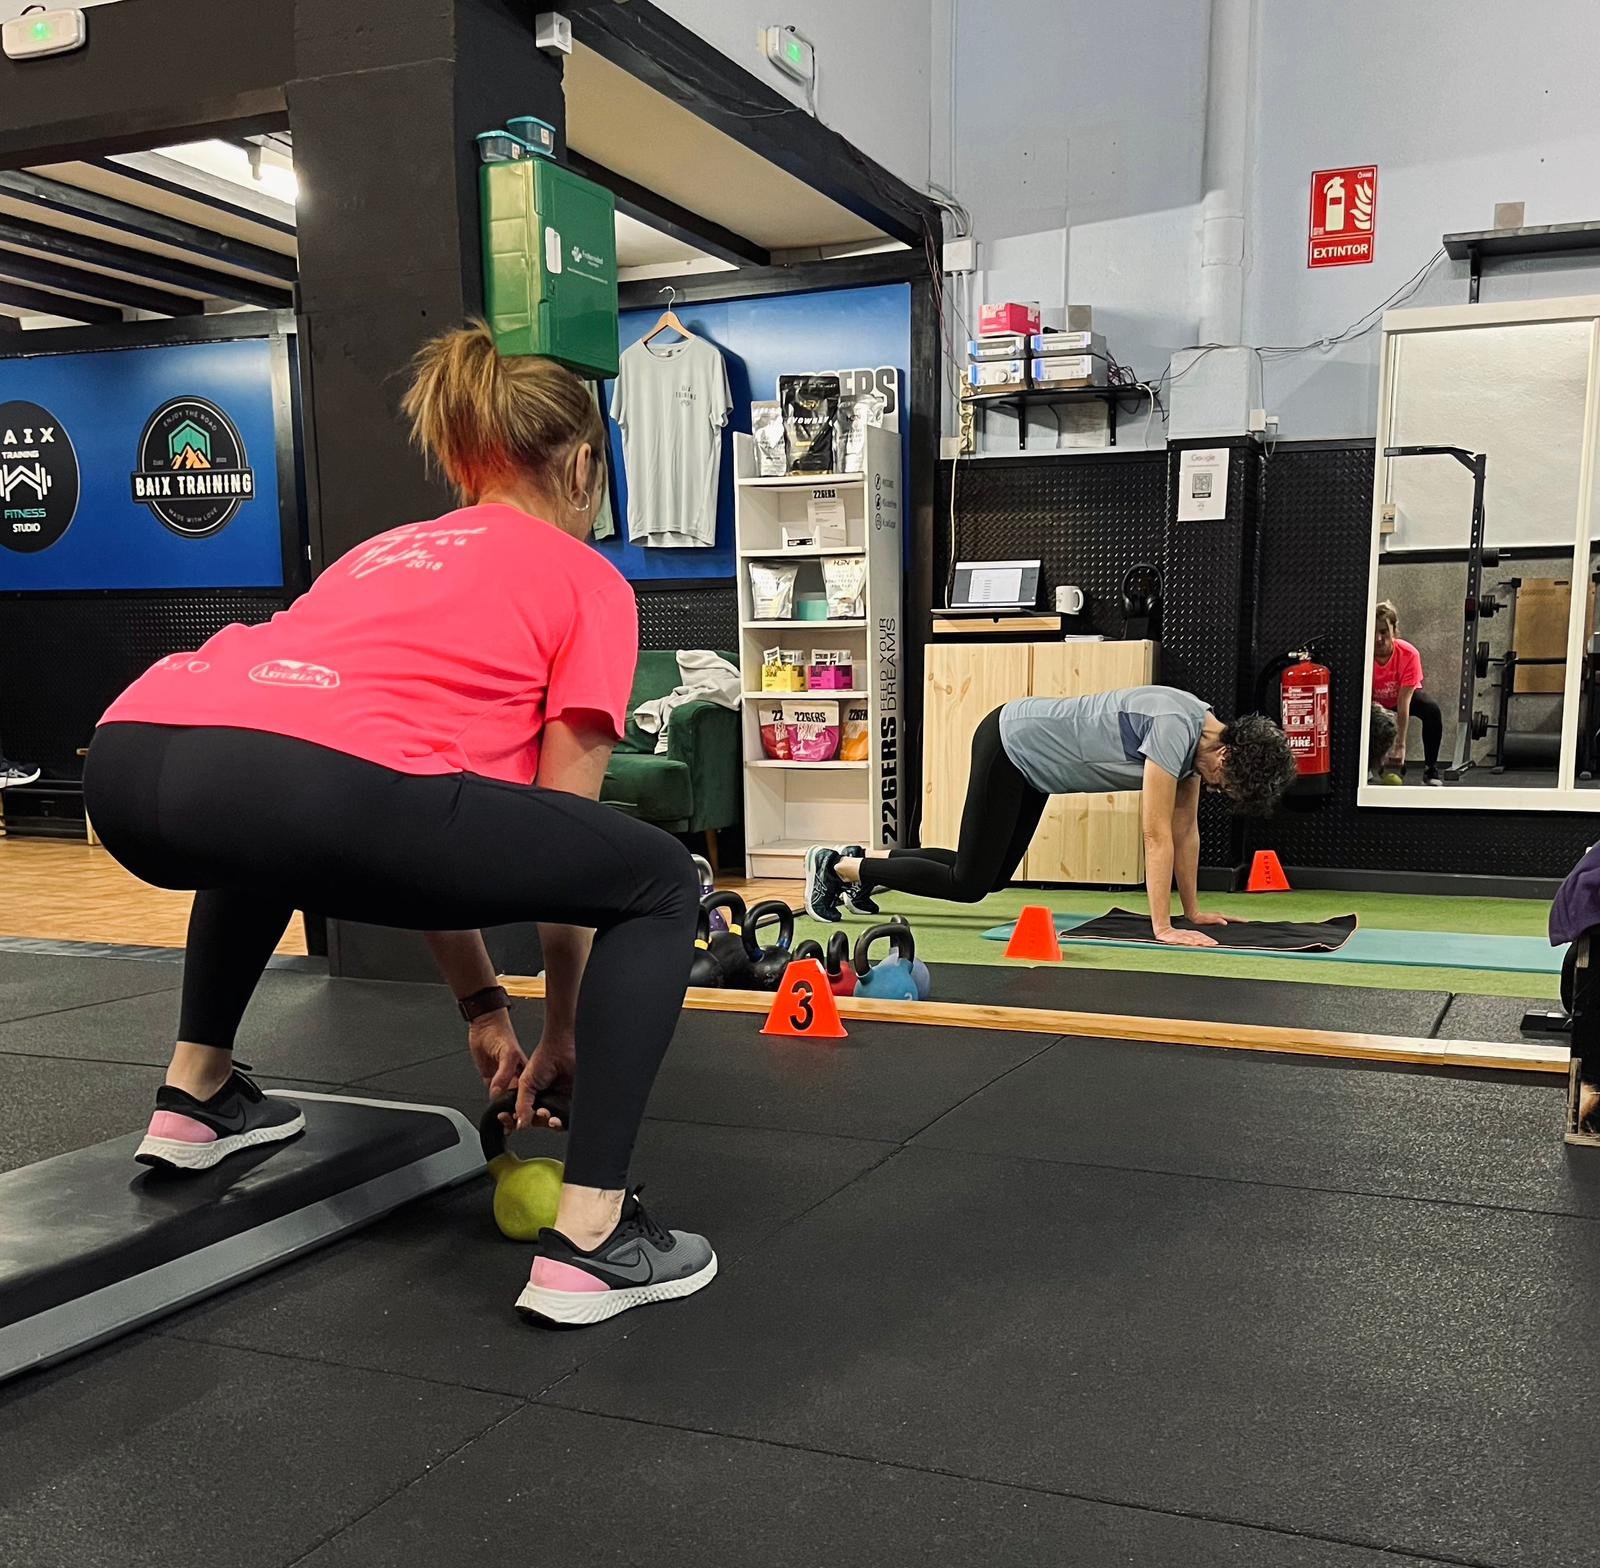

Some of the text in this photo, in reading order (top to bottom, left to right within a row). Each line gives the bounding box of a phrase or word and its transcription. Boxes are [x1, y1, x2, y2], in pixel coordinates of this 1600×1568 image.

[1313, 243, 1369, 259] EXTINTOR
[839, 368, 896, 415] ERS
[185, 410, 198, 418] THE
[3, 427, 55, 445] AIX
[1, 450, 40, 459] TRAINING
[135, 473, 252, 496] BAIX TRAINING
[813, 489, 836, 499] 226ERS
[4, 508, 47, 519] FITNESS
[203, 507, 218, 521] LOVE
[12, 523, 41, 533] STUDIO
[405, 559, 444, 571] 2018
[887, 618, 897, 711] DREAMS
[795, 711, 826, 723] 226ERS
[881, 716, 898, 845] 226ERS
[789, 981, 814, 1031] 3
